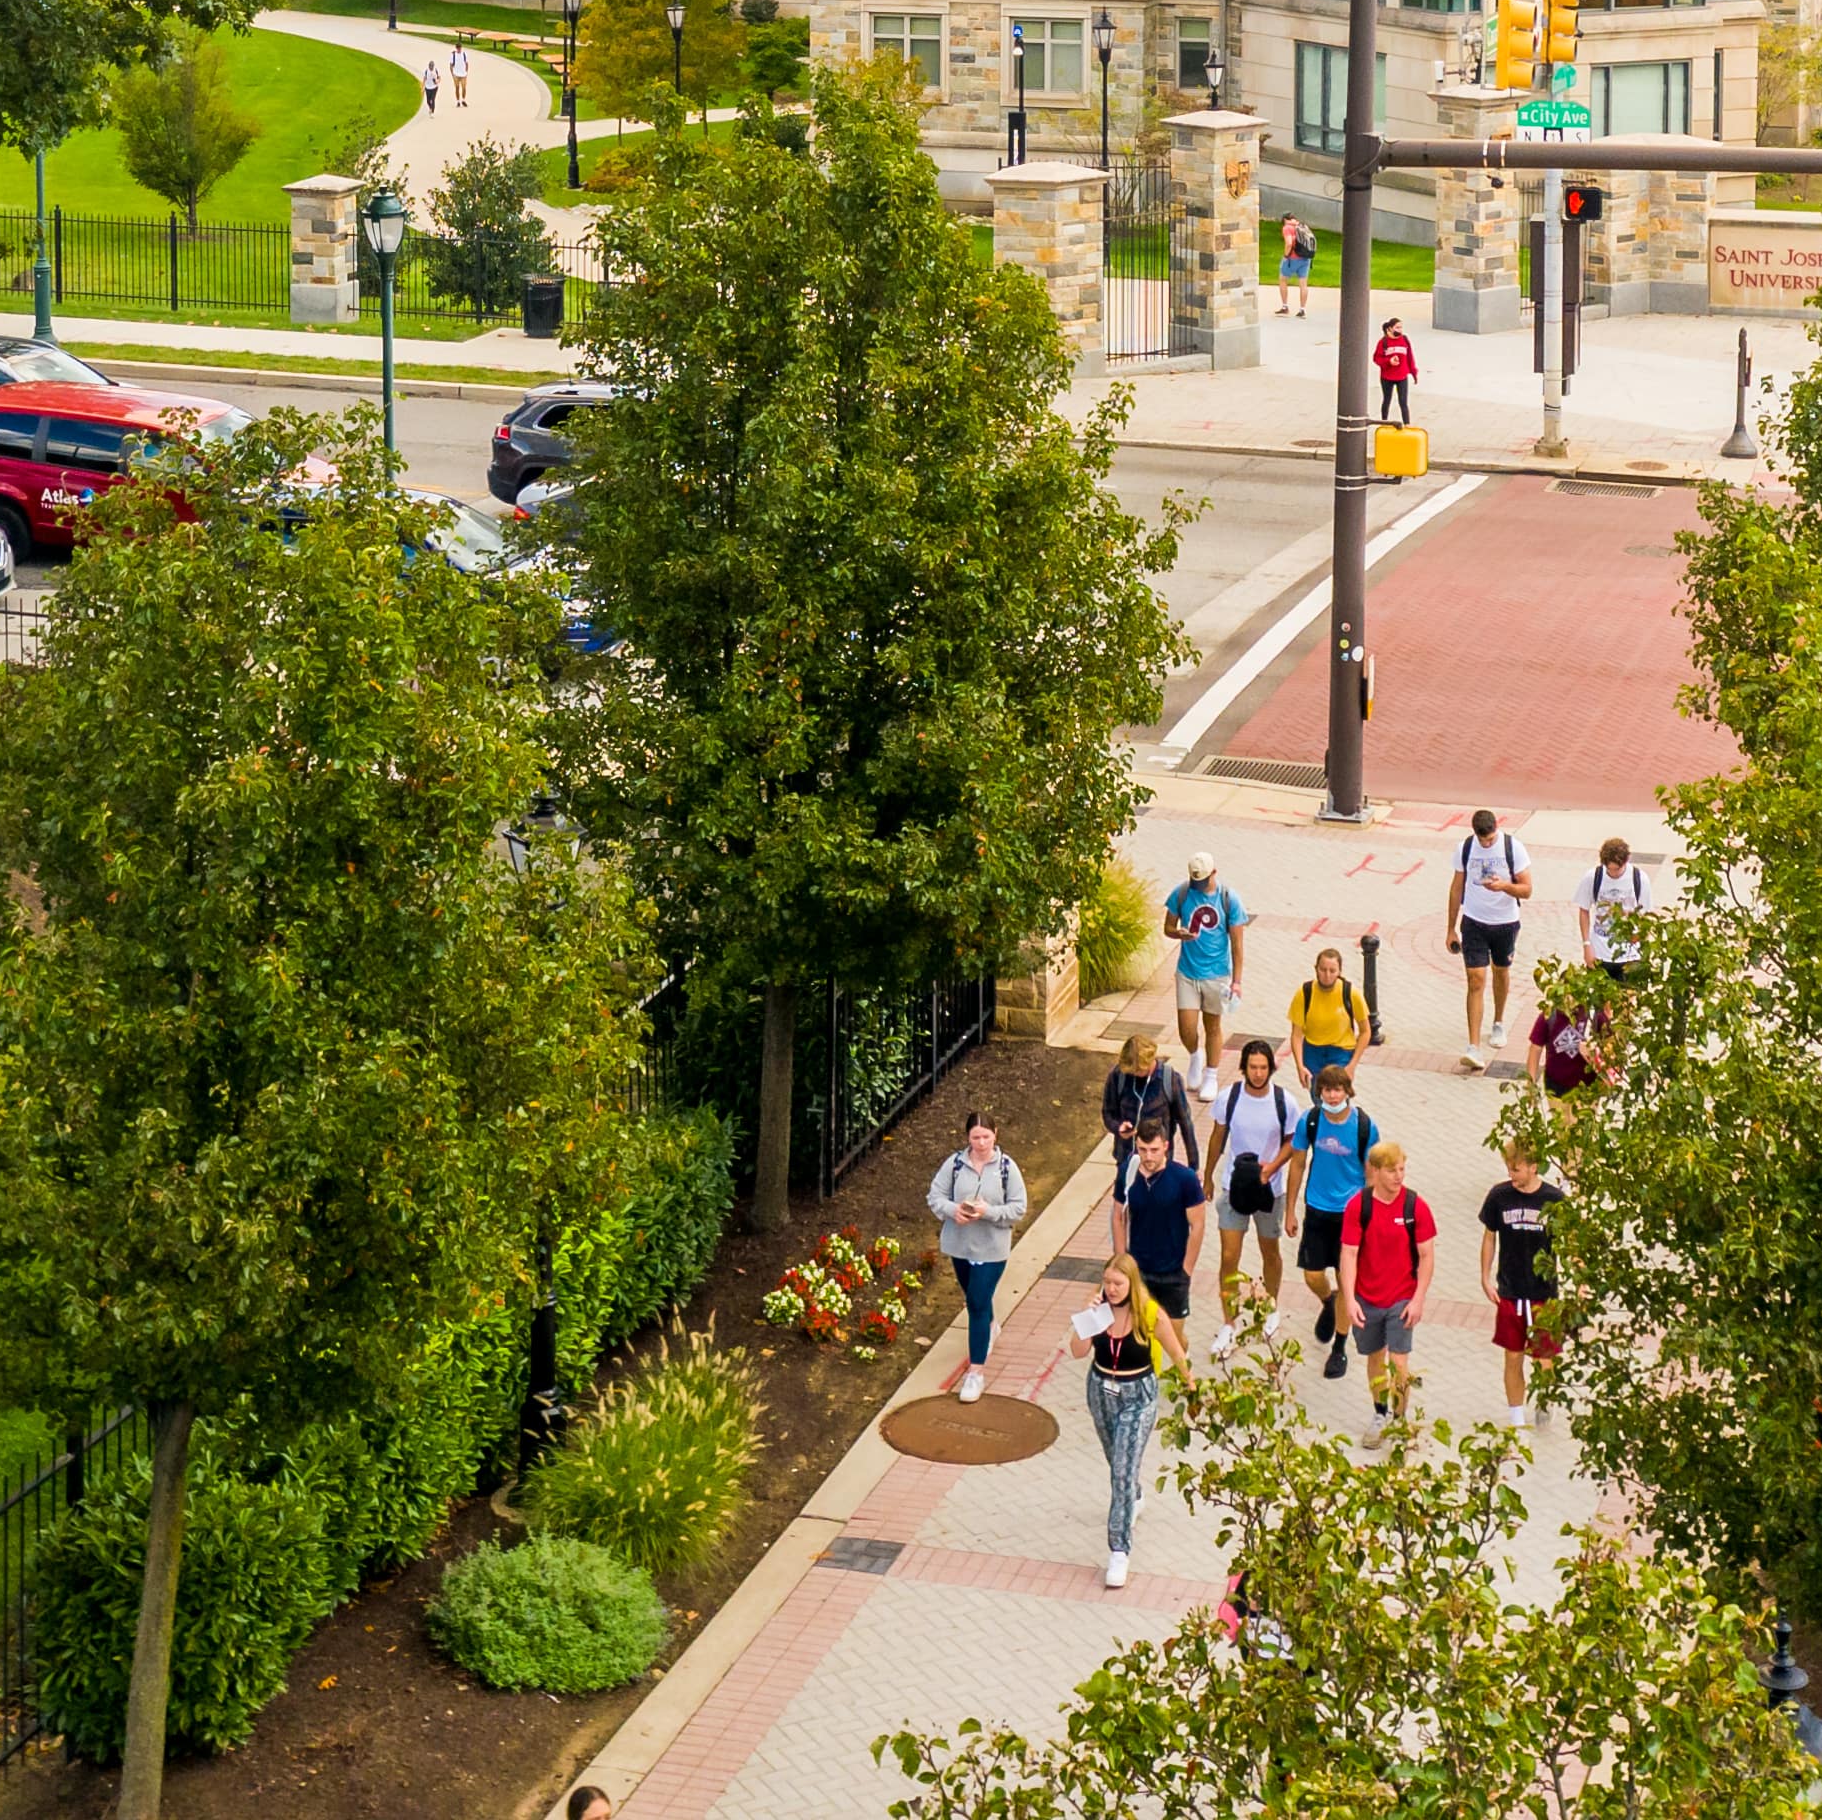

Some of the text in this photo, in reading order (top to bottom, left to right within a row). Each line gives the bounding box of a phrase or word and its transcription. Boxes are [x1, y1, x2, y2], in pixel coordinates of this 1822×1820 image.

[1530, 109, 1588, 127] City Ave
[1524, 131, 1532, 142] N
[41, 487, 79, 505] Atlas
